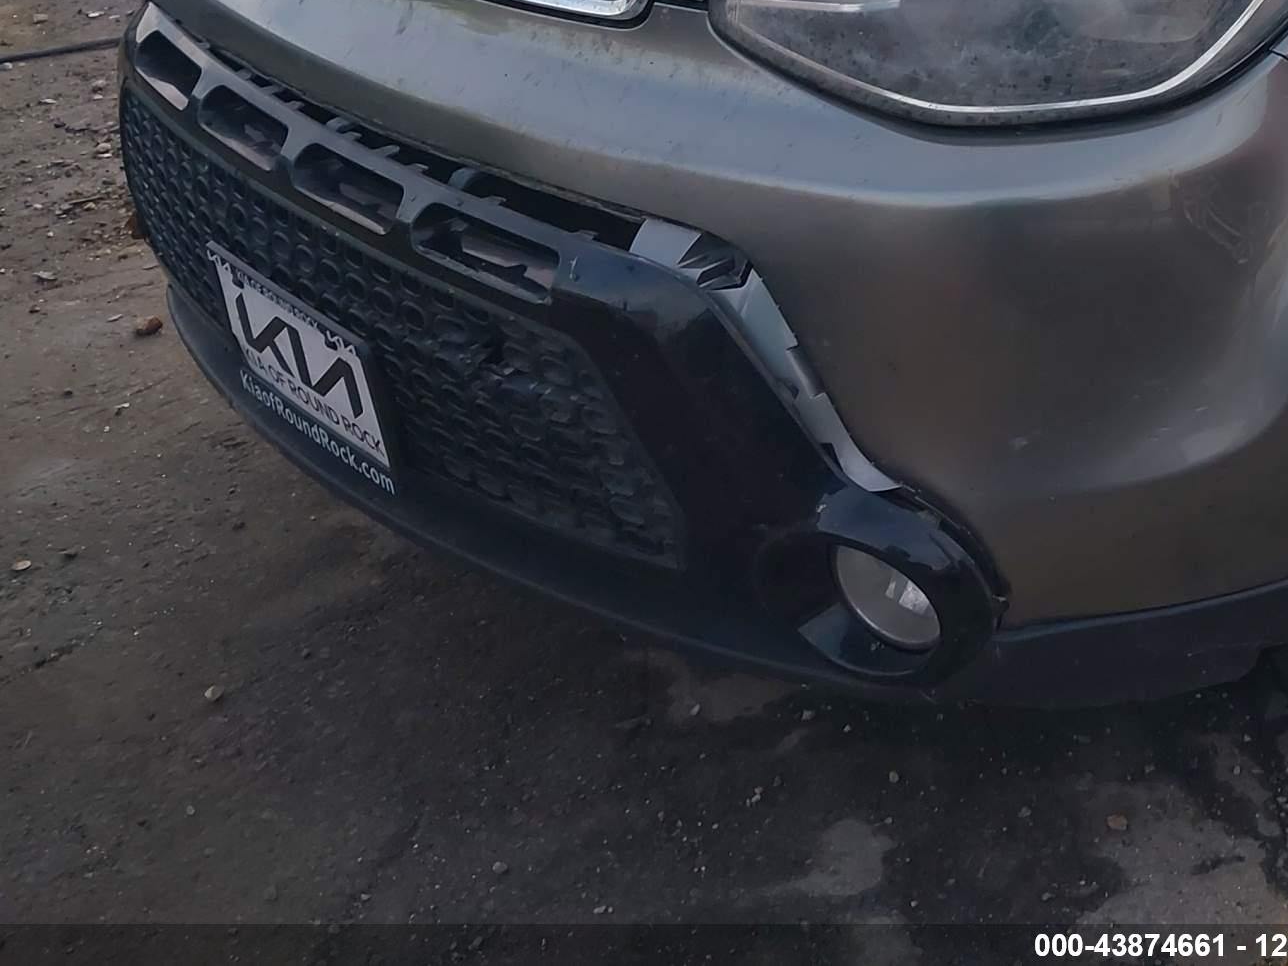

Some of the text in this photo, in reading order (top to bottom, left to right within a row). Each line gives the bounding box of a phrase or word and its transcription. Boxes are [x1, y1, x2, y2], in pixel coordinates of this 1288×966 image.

[239, 368, 396, 496] KiaofRoundRock.com
[288, 382, 340, 426] ROUND
[340, 414, 386, 457] ROCK
